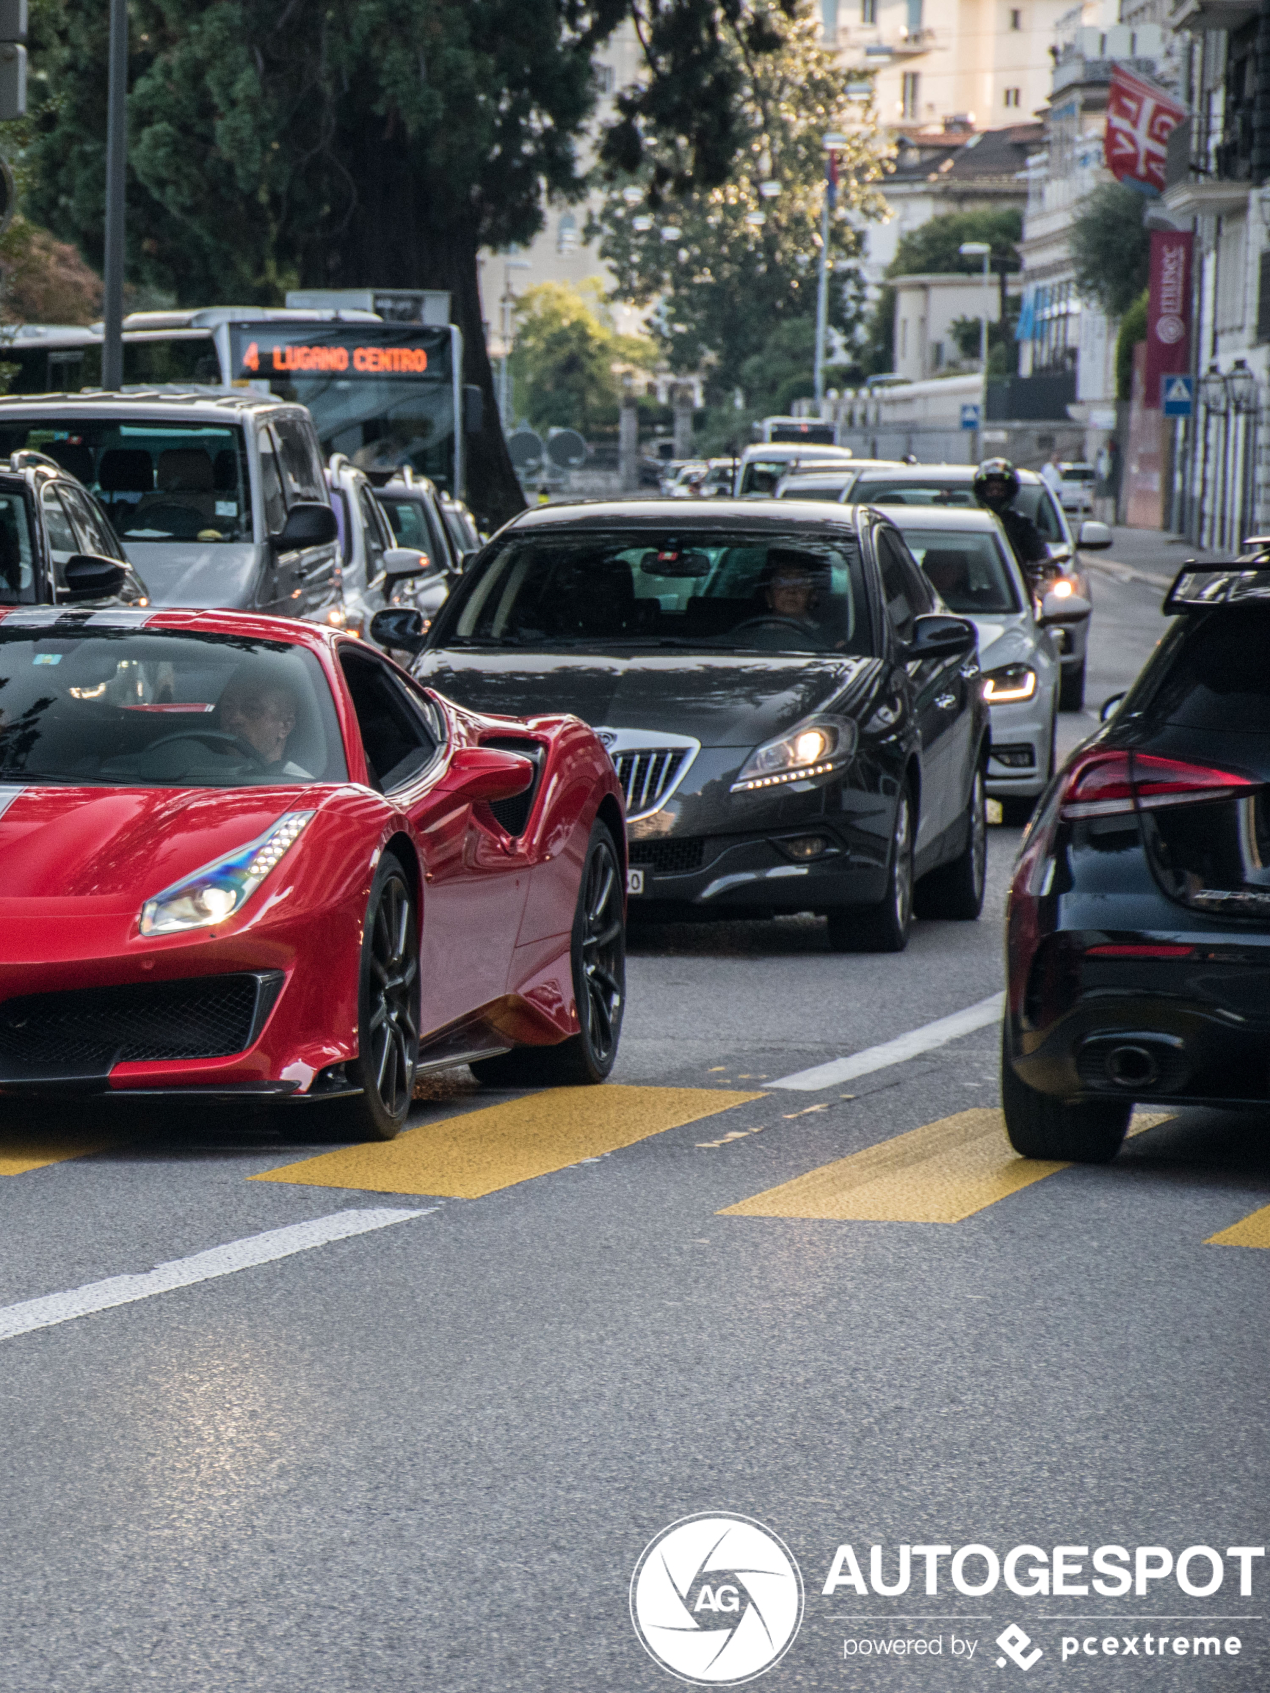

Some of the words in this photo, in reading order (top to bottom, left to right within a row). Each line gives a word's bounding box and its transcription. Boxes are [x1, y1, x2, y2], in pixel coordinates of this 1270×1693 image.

[243, 342, 260, 371] 4
[272, 346, 350, 372] LUGANO
[352, 347, 428, 373] CENTRO
